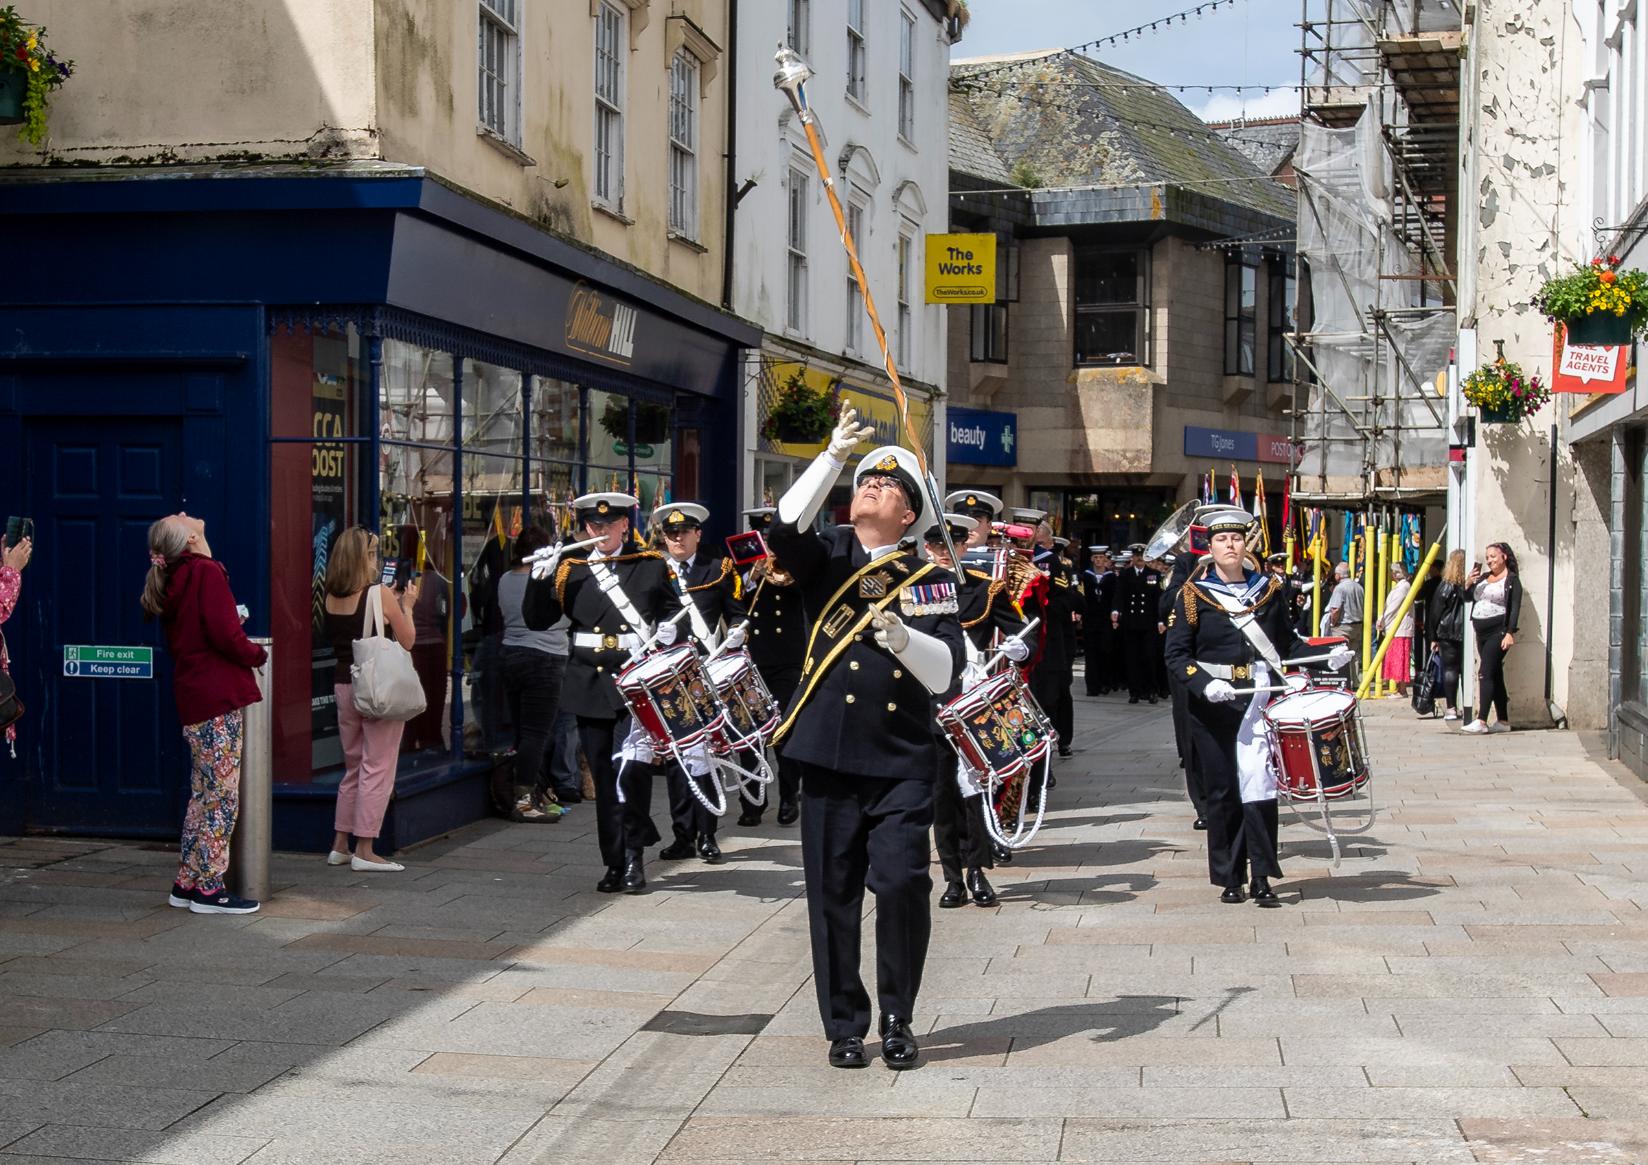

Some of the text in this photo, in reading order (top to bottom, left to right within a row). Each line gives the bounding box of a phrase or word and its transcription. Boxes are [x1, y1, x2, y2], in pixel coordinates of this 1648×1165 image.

[946, 247, 974, 261] The
[938, 262, 983, 275] Works
[936, 288, 985, 296] TheWorks.co.uk
[608, 303, 637, 358] HILL
[1569, 351, 1609, 365] TRAVEL
[1565, 361, 1610, 374] AGENTS
[950, 422, 986, 450] beauty
[1271, 441, 1286, 457] POST
[96, 649, 134, 659] Fire exit
[90, 664, 141, 674] Keep clear
